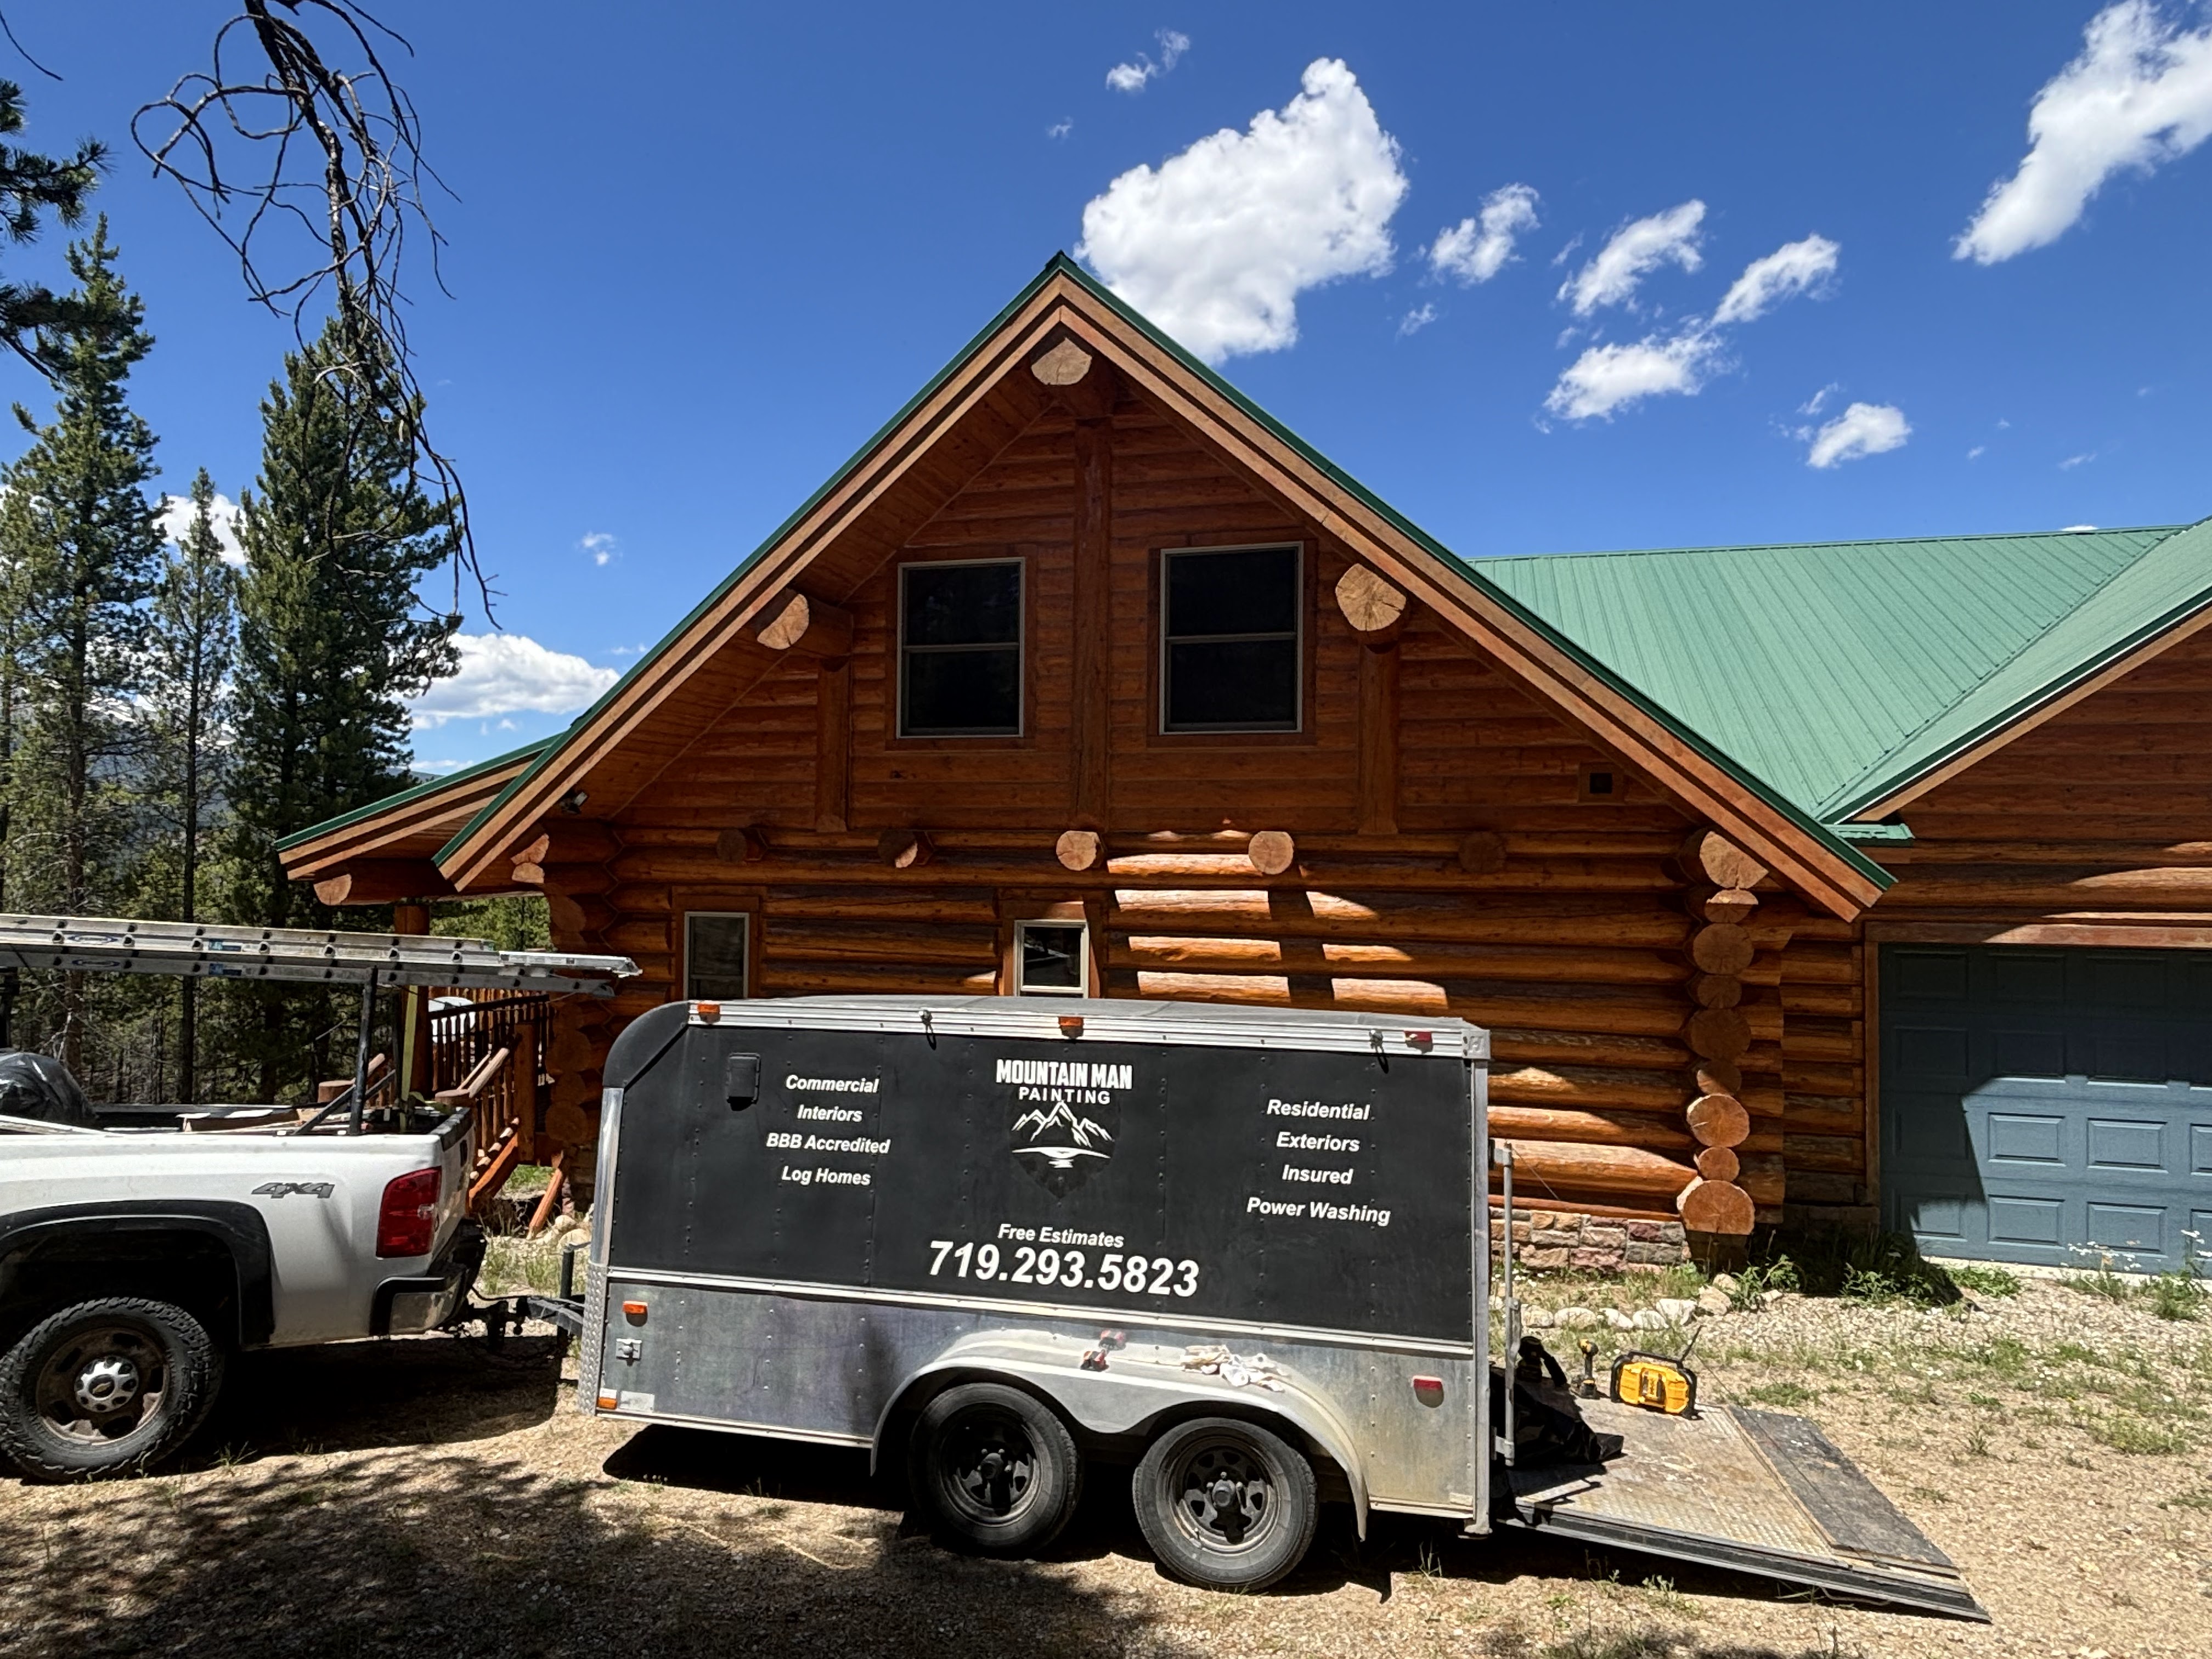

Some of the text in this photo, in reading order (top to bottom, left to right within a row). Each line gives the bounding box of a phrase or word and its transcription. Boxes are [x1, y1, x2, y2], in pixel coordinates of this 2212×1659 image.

[785, 1074, 879, 1093] Commercial
[996, 1059, 1133, 1090] MOUNTAIN MAN
[1018, 1086, 1111, 1104] PAINTING
[797, 1104, 863, 1122] Interiors
[1266, 1098, 1371, 1121] Residential
[766, 1132, 891, 1154] BBB Accredited
[1276, 1131, 1361, 1153] Exteriors
[781, 1165, 872, 1186] Log Homes
[1282, 1164, 1354, 1185] Insured
[1246, 1196, 1391, 1227] Power Washing
[997, 1223, 1125, 1249] Free Estimates
[928, 1240, 1200, 1298] 719.293.5823
